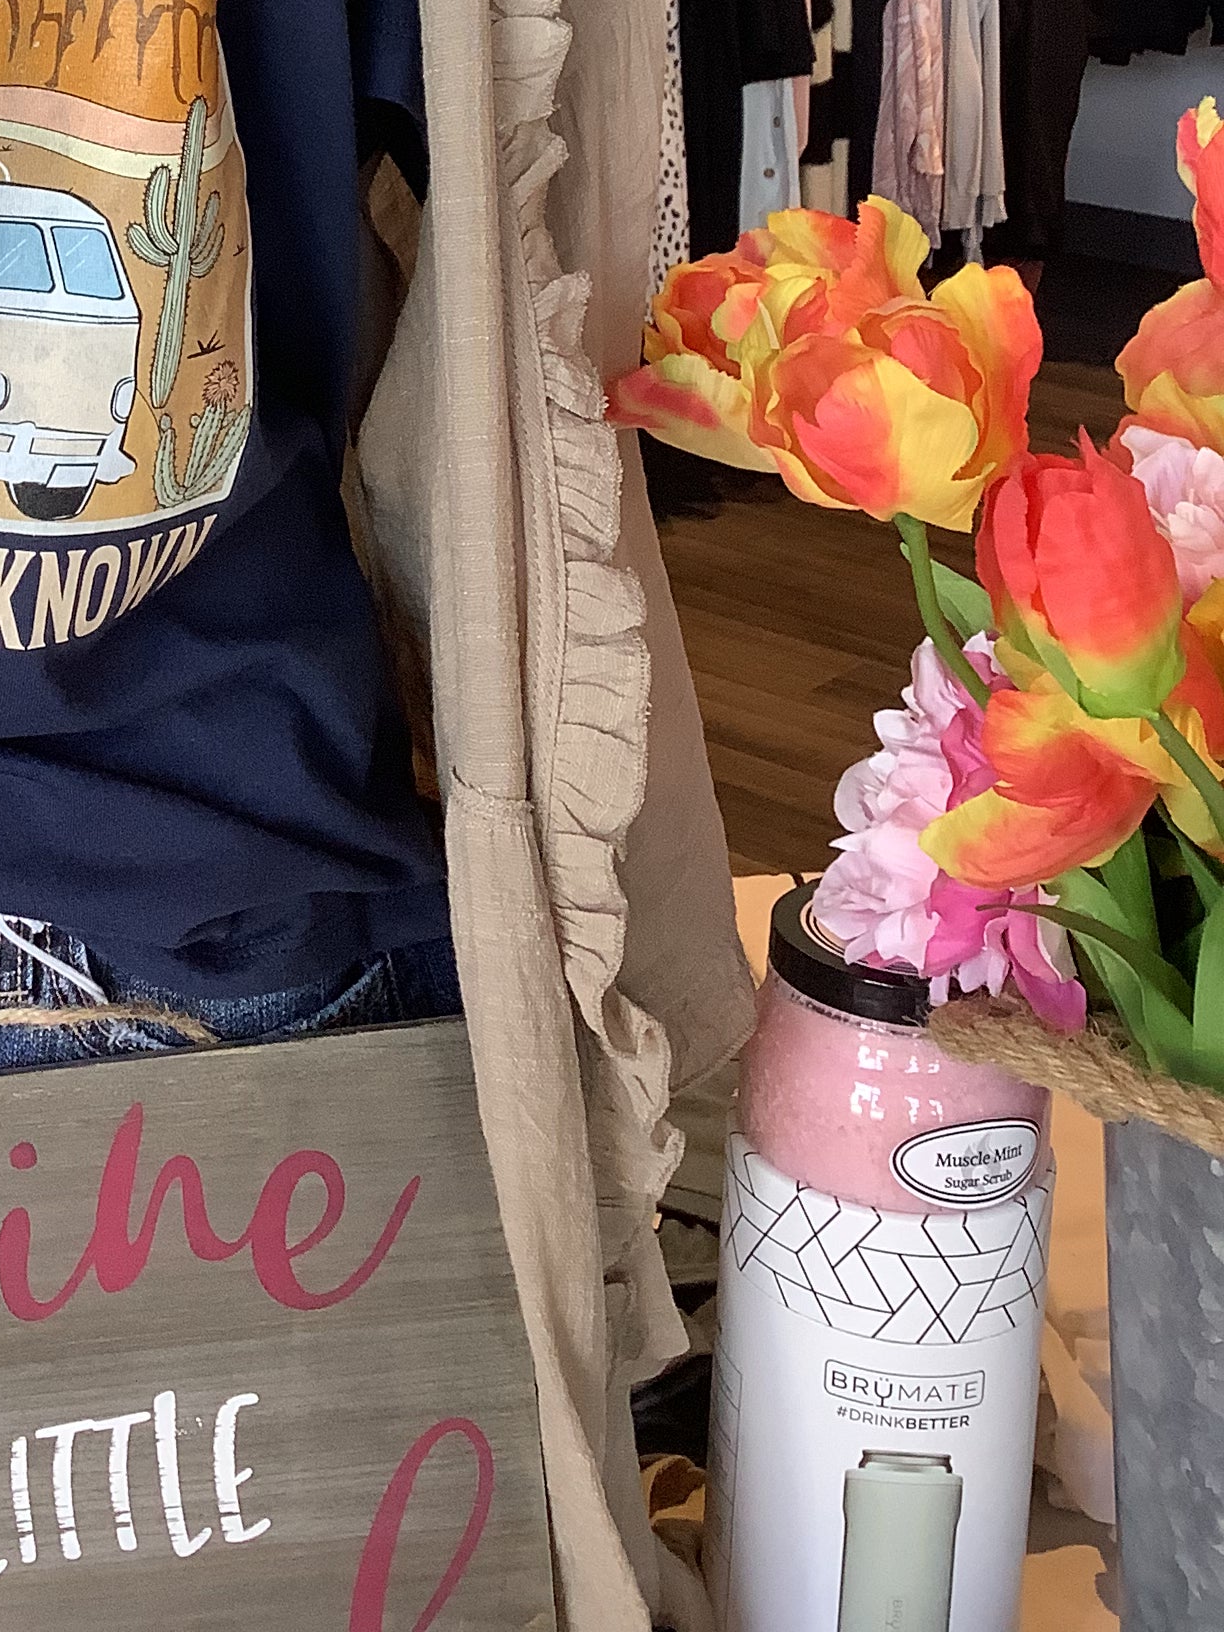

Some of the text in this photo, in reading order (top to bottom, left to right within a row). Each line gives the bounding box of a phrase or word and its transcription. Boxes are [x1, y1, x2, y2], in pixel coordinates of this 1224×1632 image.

[935, 1144, 1023, 1168] Muscle Mint
[944, 1169, 1013, 1191] Sugar Scrub
[836, 1405, 971, 1431] #DRINKBETTER
